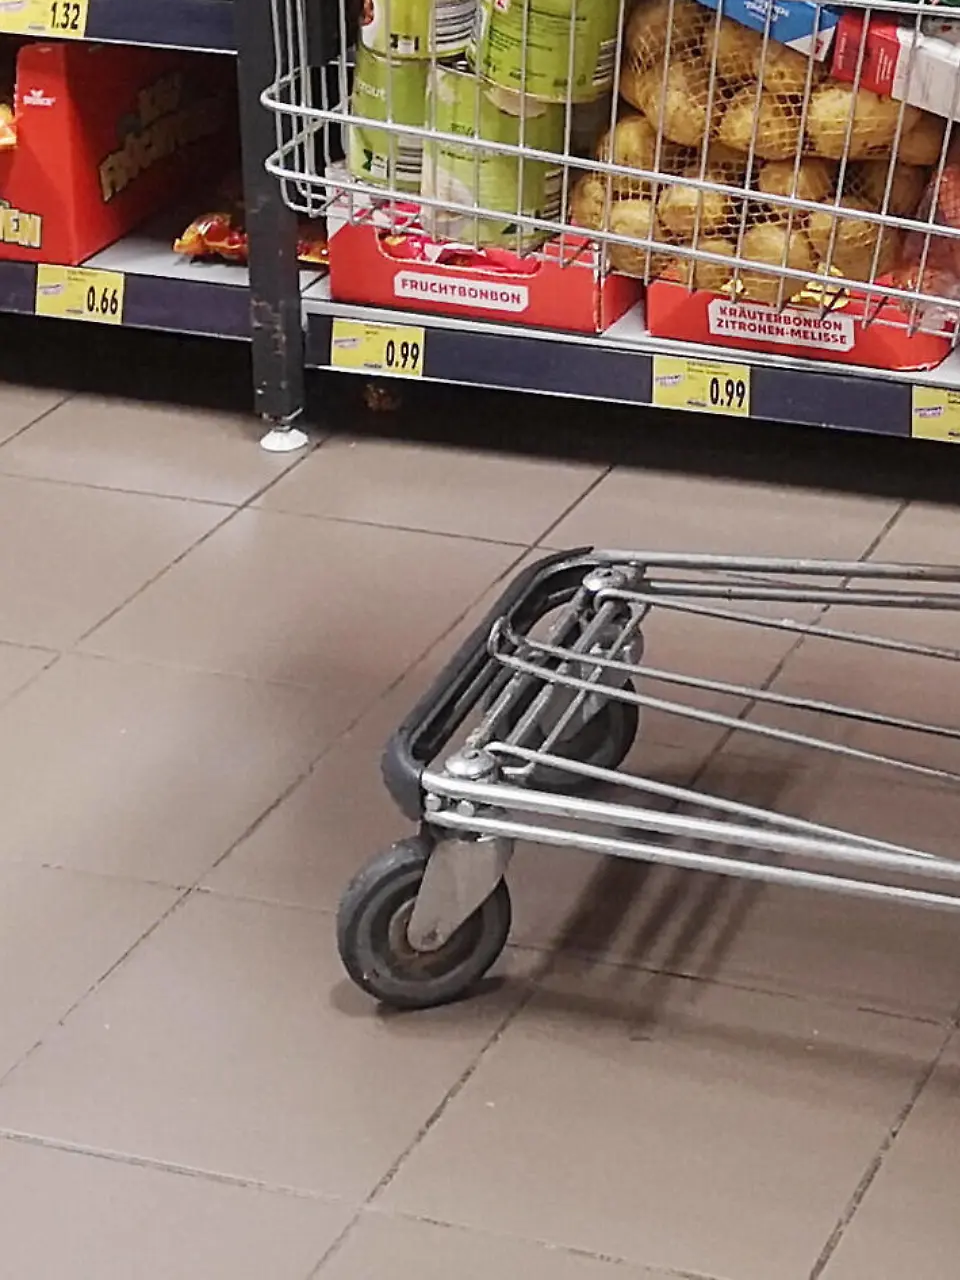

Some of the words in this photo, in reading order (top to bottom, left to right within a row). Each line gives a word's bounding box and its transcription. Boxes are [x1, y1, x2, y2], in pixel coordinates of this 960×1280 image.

[50, 0, 81, 30] 1.32
[87, 285, 119, 315] 0.66
[400, 278, 523, 306] FRUCHTBONBON
[715, 318, 848, 346] ZITRONEN-MELISSE
[718, 305, 843, 332] KRÄUTERBONBON
[385, 338, 420, 370] 0.99
[708, 376, 746, 409] 0.99
